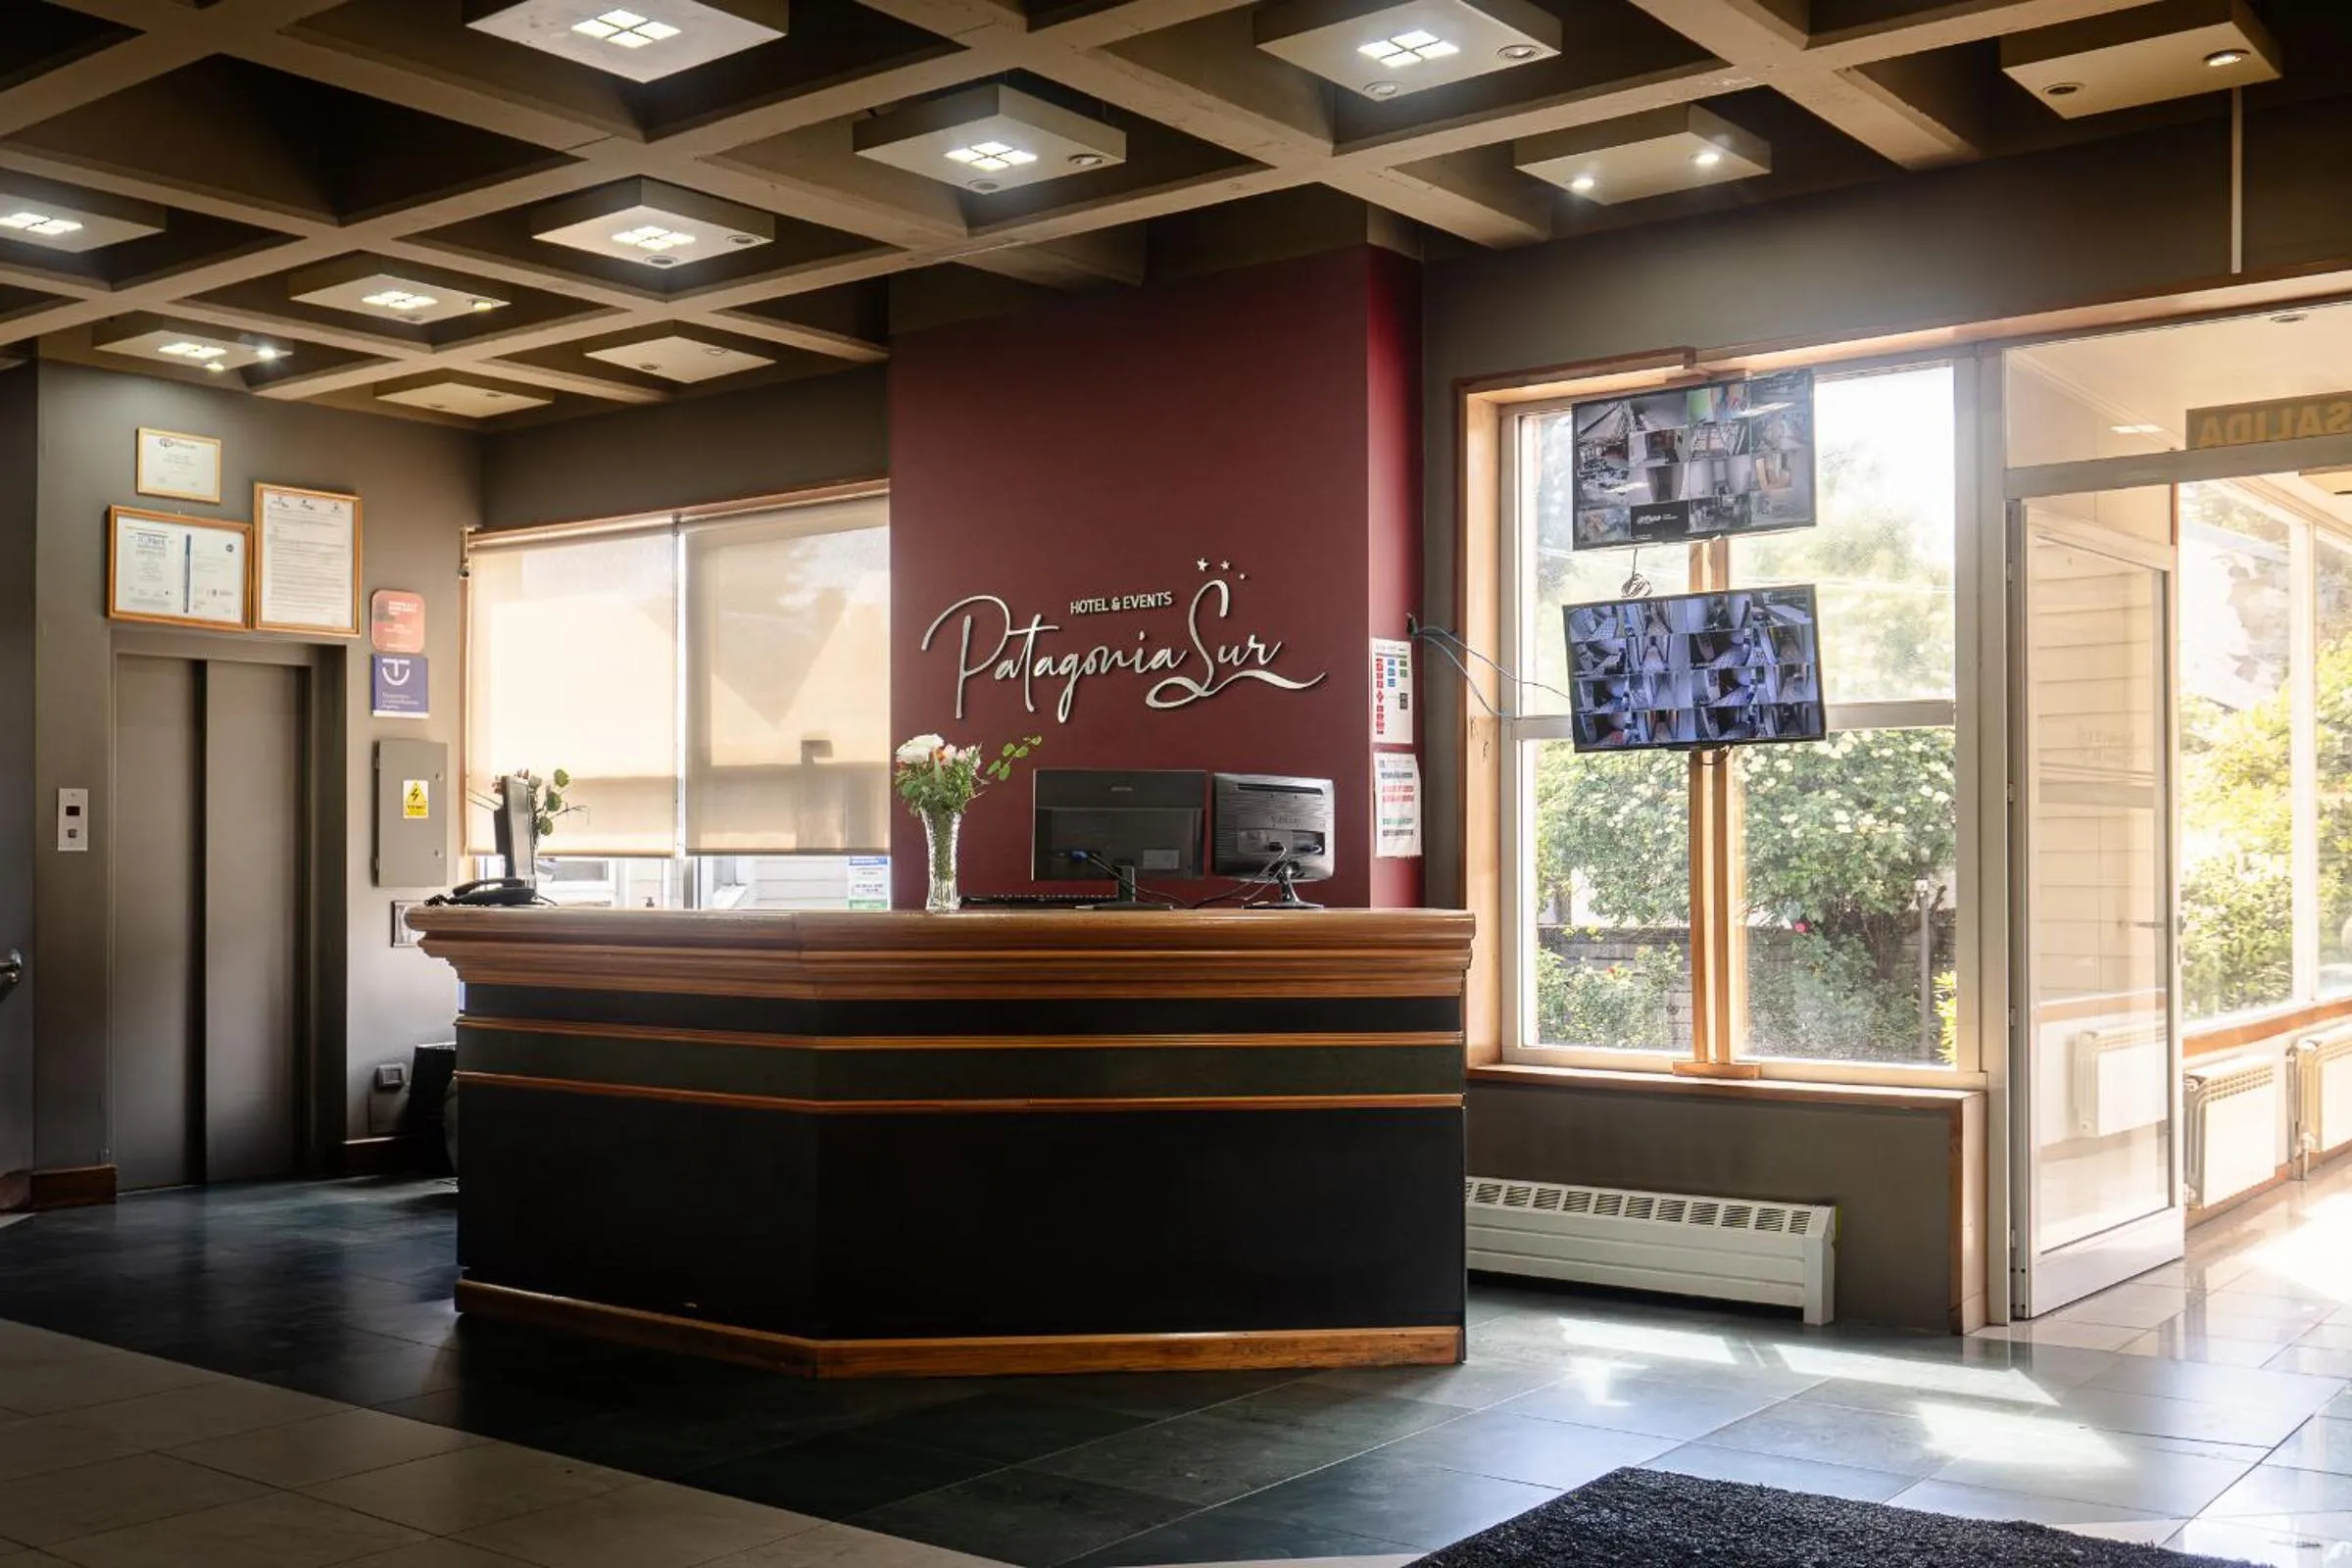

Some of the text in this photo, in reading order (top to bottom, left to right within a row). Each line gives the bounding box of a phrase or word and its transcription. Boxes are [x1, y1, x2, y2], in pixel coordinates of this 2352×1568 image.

[1070, 590, 1173, 615] HOTEL & EVENTS
[921, 595, 1188, 723] Patagonia
[1145, 579, 1326, 709] Sur
